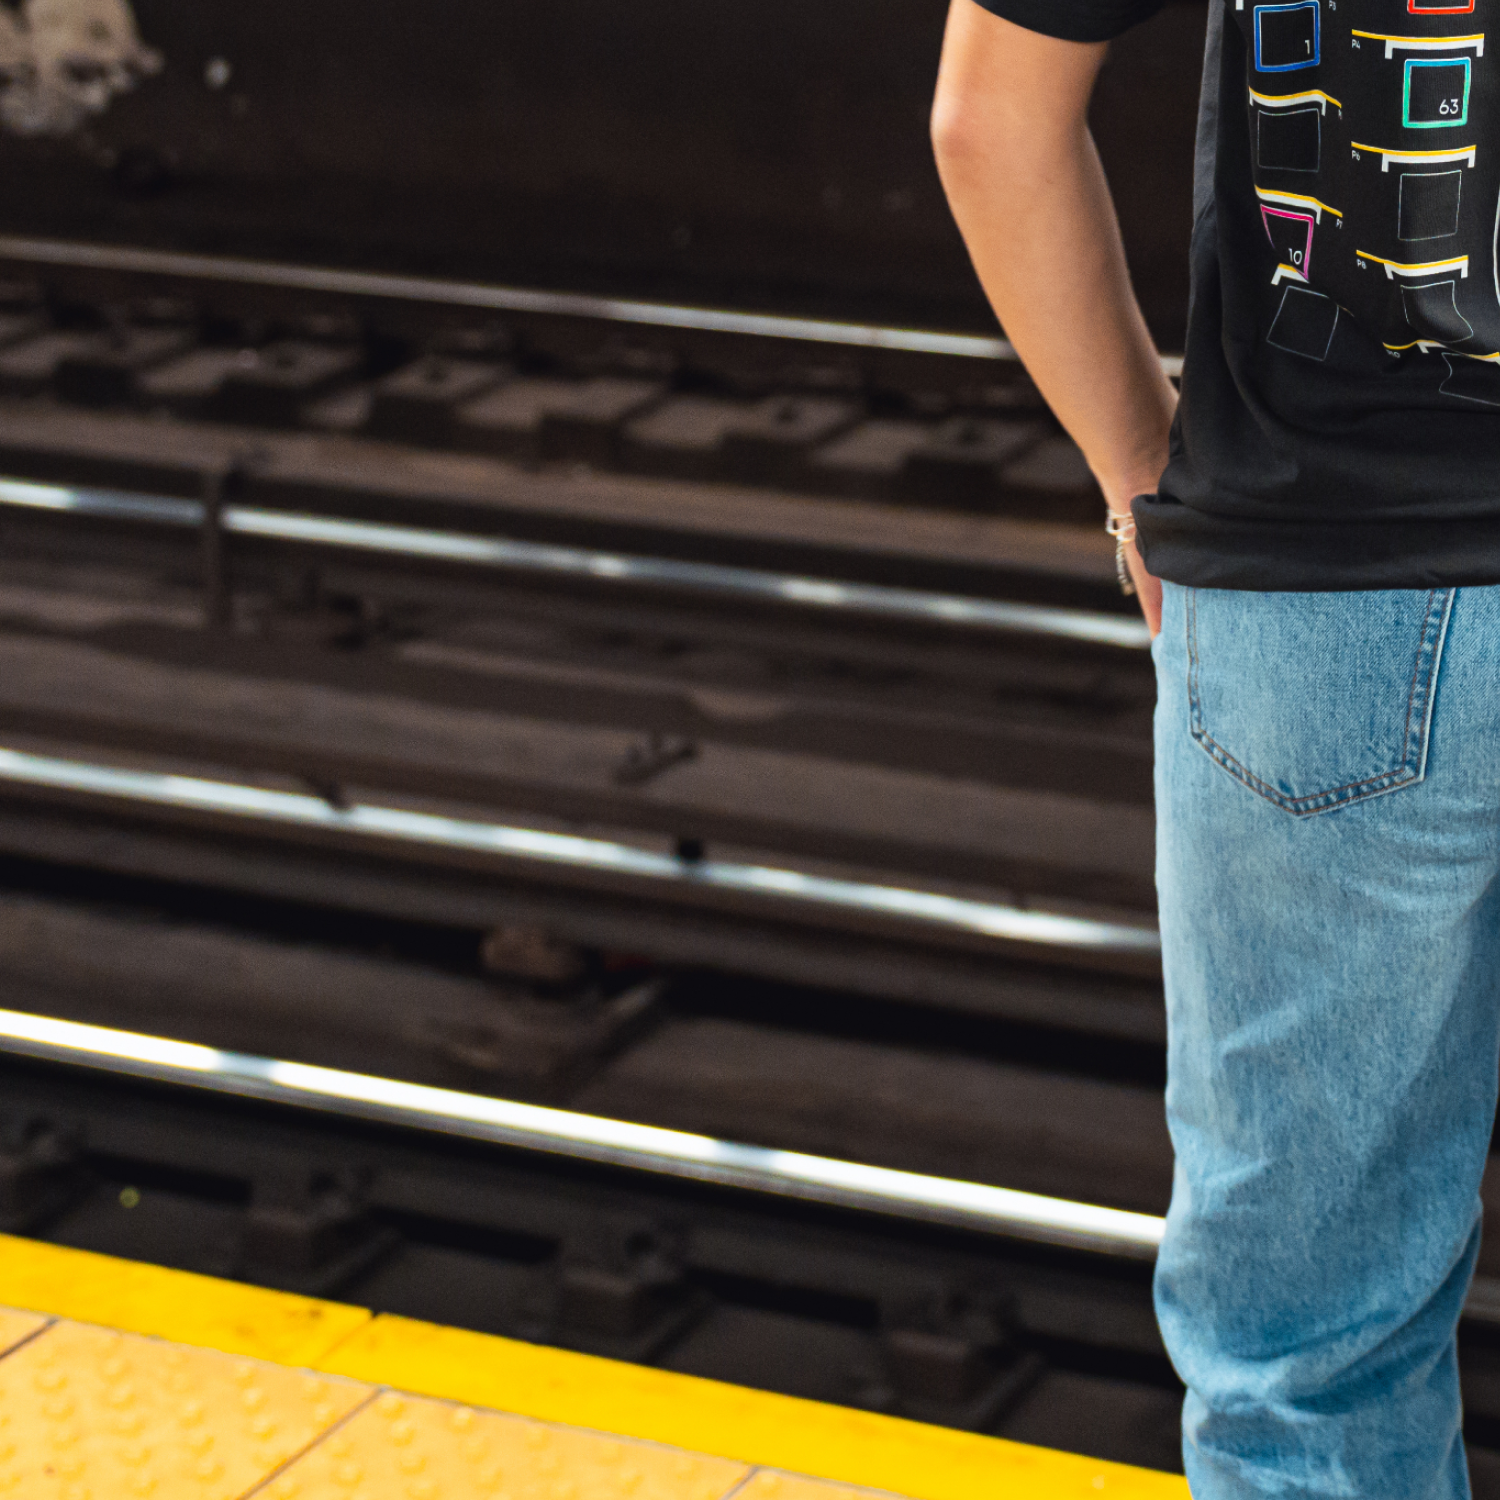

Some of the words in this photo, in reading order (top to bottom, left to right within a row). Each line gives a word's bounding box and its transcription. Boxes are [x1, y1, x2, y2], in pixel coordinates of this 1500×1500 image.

[1304, 39, 1310, 54] 1
[1351, 39, 1361, 49] P4
[1438, 98, 1459, 115] 63
[1288, 247, 1303, 265] 10
